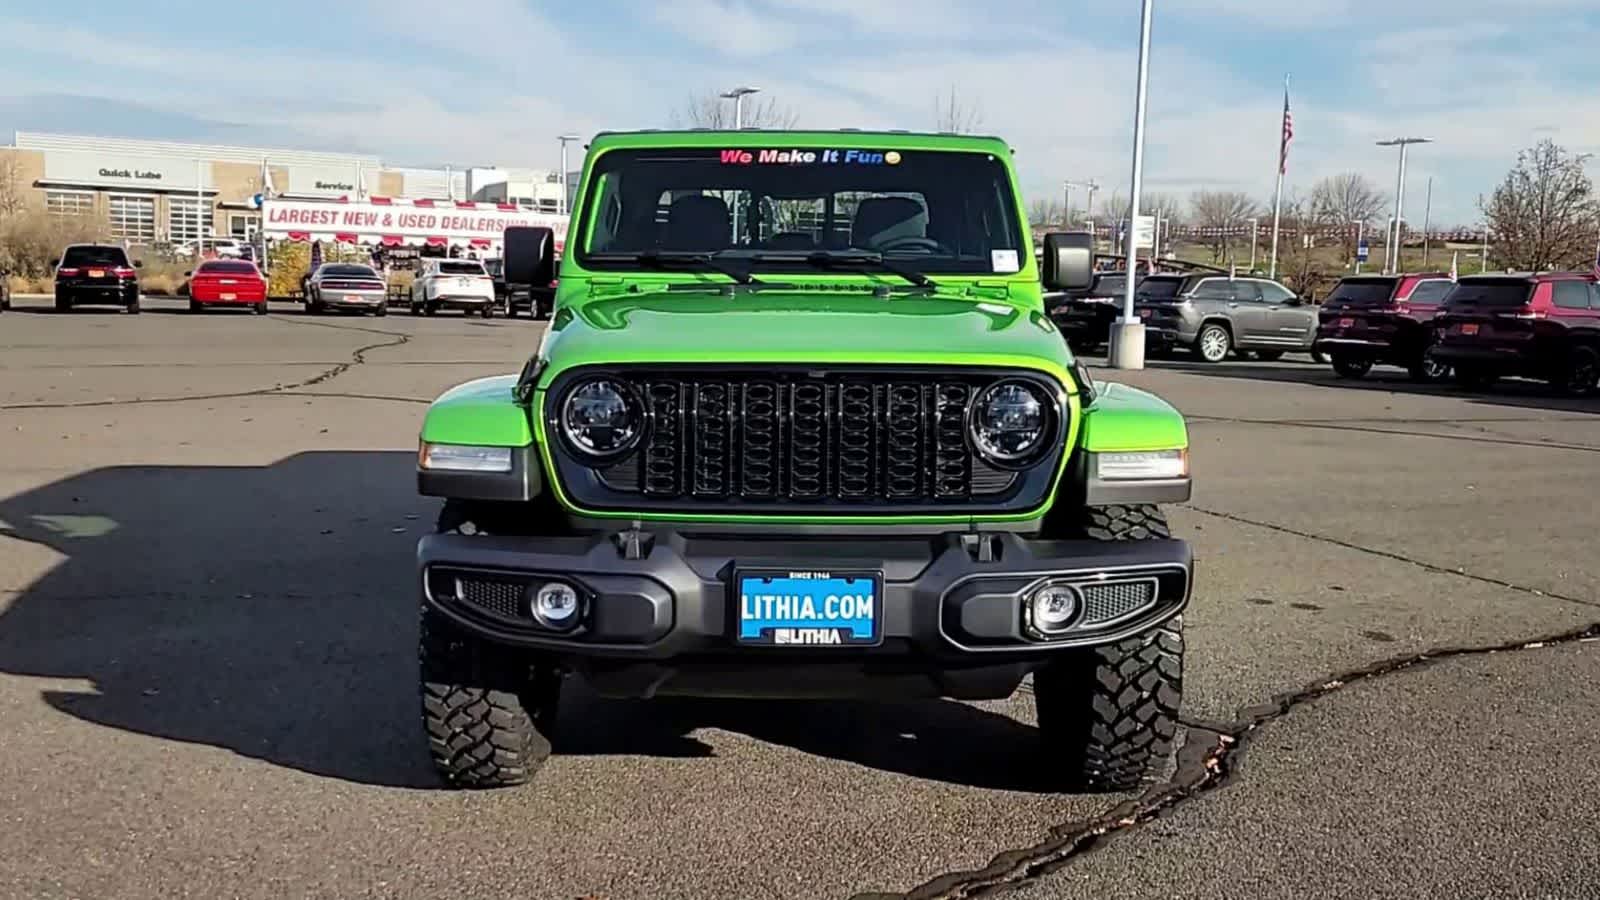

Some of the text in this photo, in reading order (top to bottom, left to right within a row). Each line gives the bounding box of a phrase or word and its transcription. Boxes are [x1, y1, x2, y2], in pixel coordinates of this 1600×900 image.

[720, 150, 883, 164] We Make It Fun
[98, 168, 162, 179] Quick Lube
[315, 181, 353, 191] Service
[268, 207, 338, 225] LARGEST
[343, 211, 378, 226] NEW
[382, 213, 392, 227] &
[398, 214, 436, 229] USED
[741, 594, 874, 620] LITHIA.COM
[790, 628, 842, 644] LITHIA
